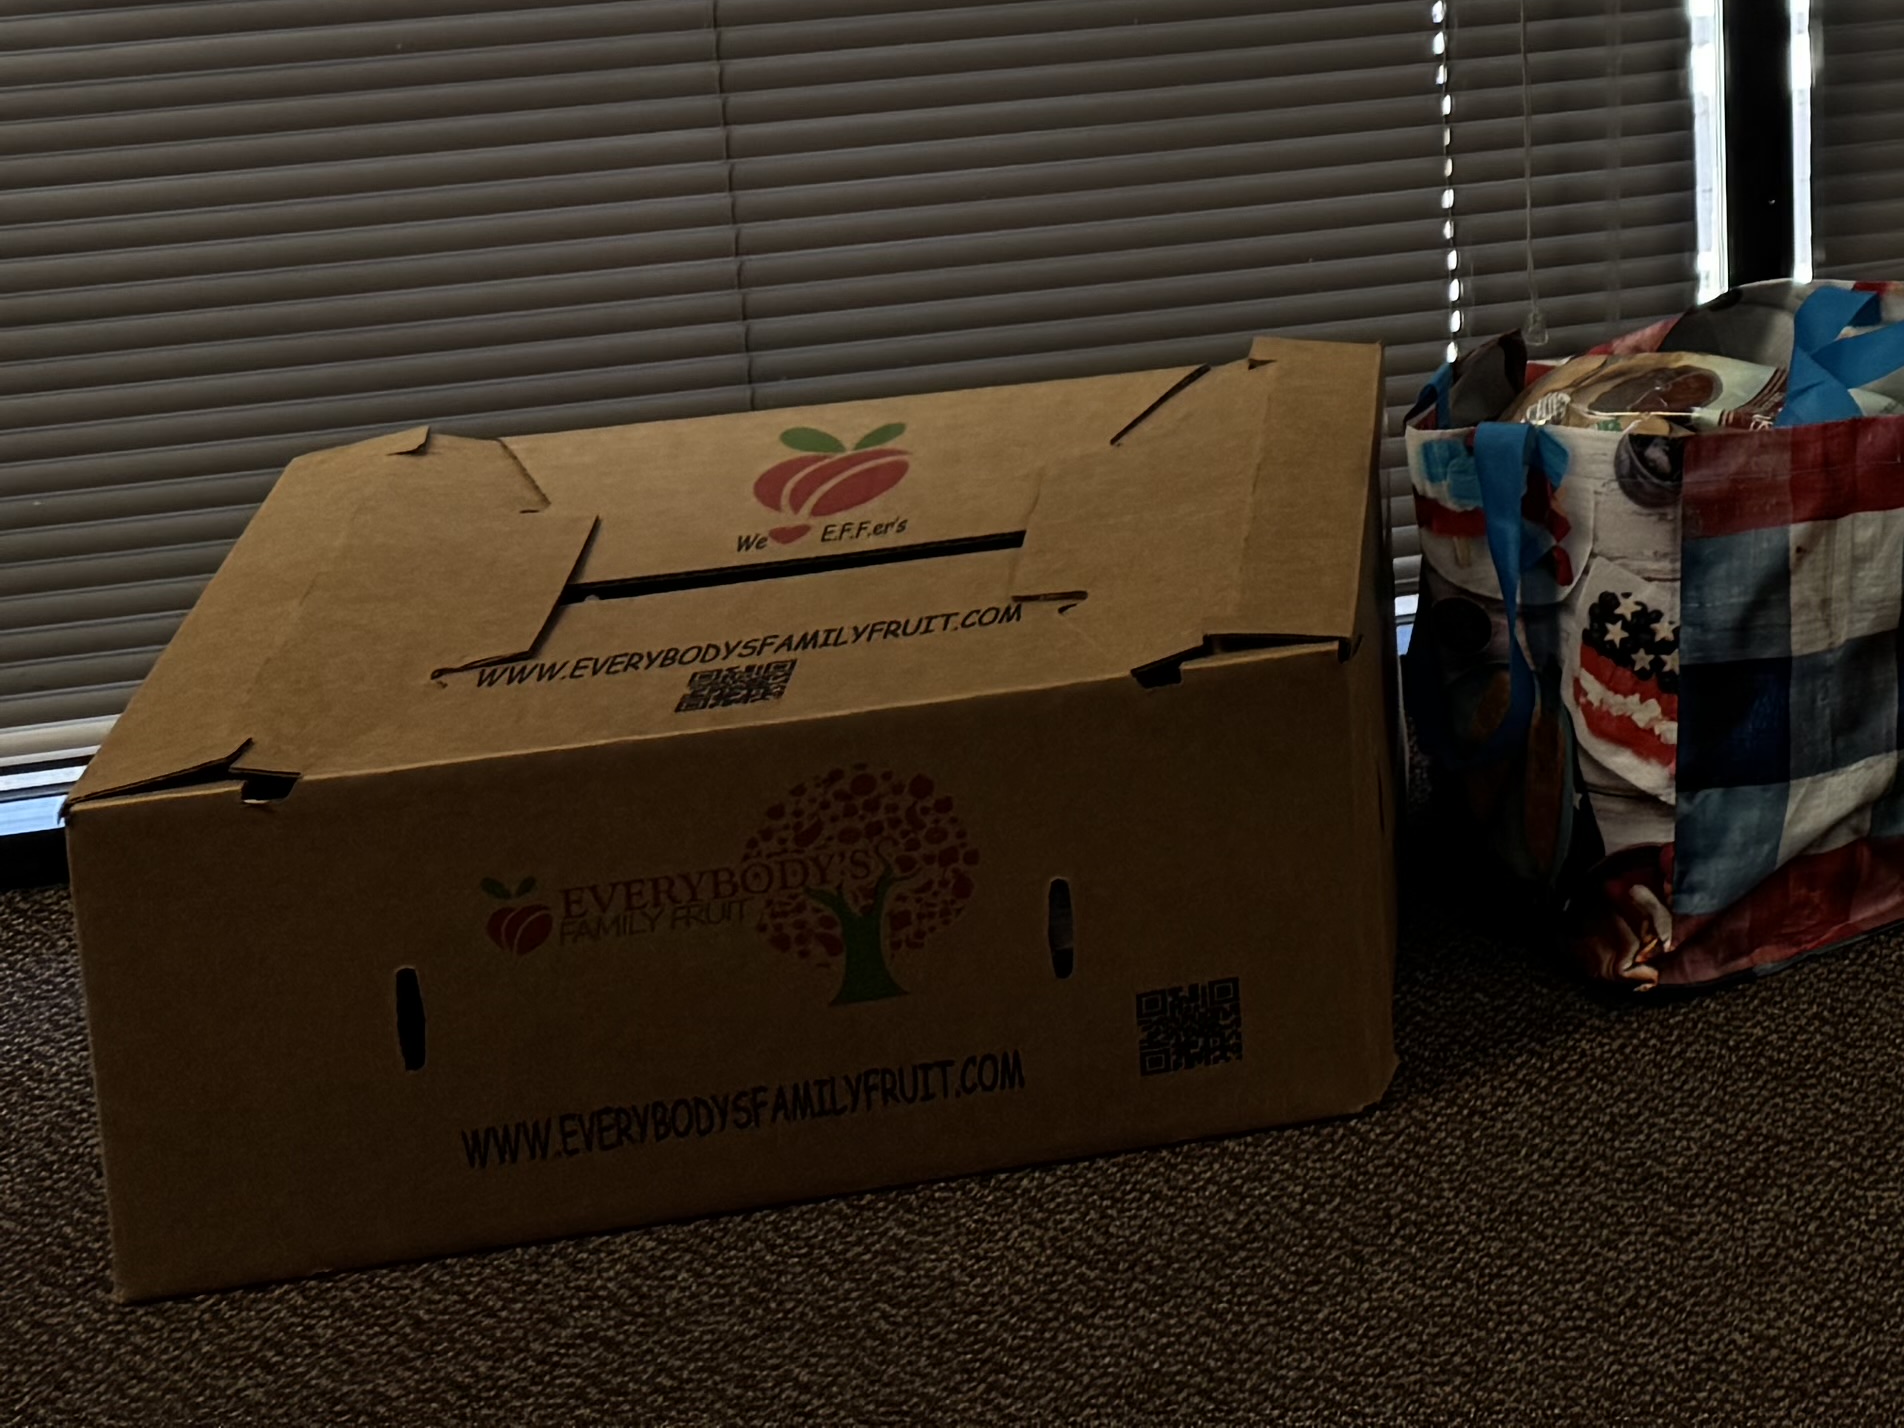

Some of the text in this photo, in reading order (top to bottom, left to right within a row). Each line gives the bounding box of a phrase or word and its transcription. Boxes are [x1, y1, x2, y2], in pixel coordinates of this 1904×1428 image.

[735, 533, 768, 553] We
[476, 603, 1023, 688] WWW.EVERYBODYSFAMILYFRUIT.COM
[559, 849, 871, 917] EVERYBODY'S
[559, 896, 754, 946] FAMILY FRUIT
[460, 1048, 1025, 1170] WWW.EVERYBODYSFAMILYFRUIT.COM
